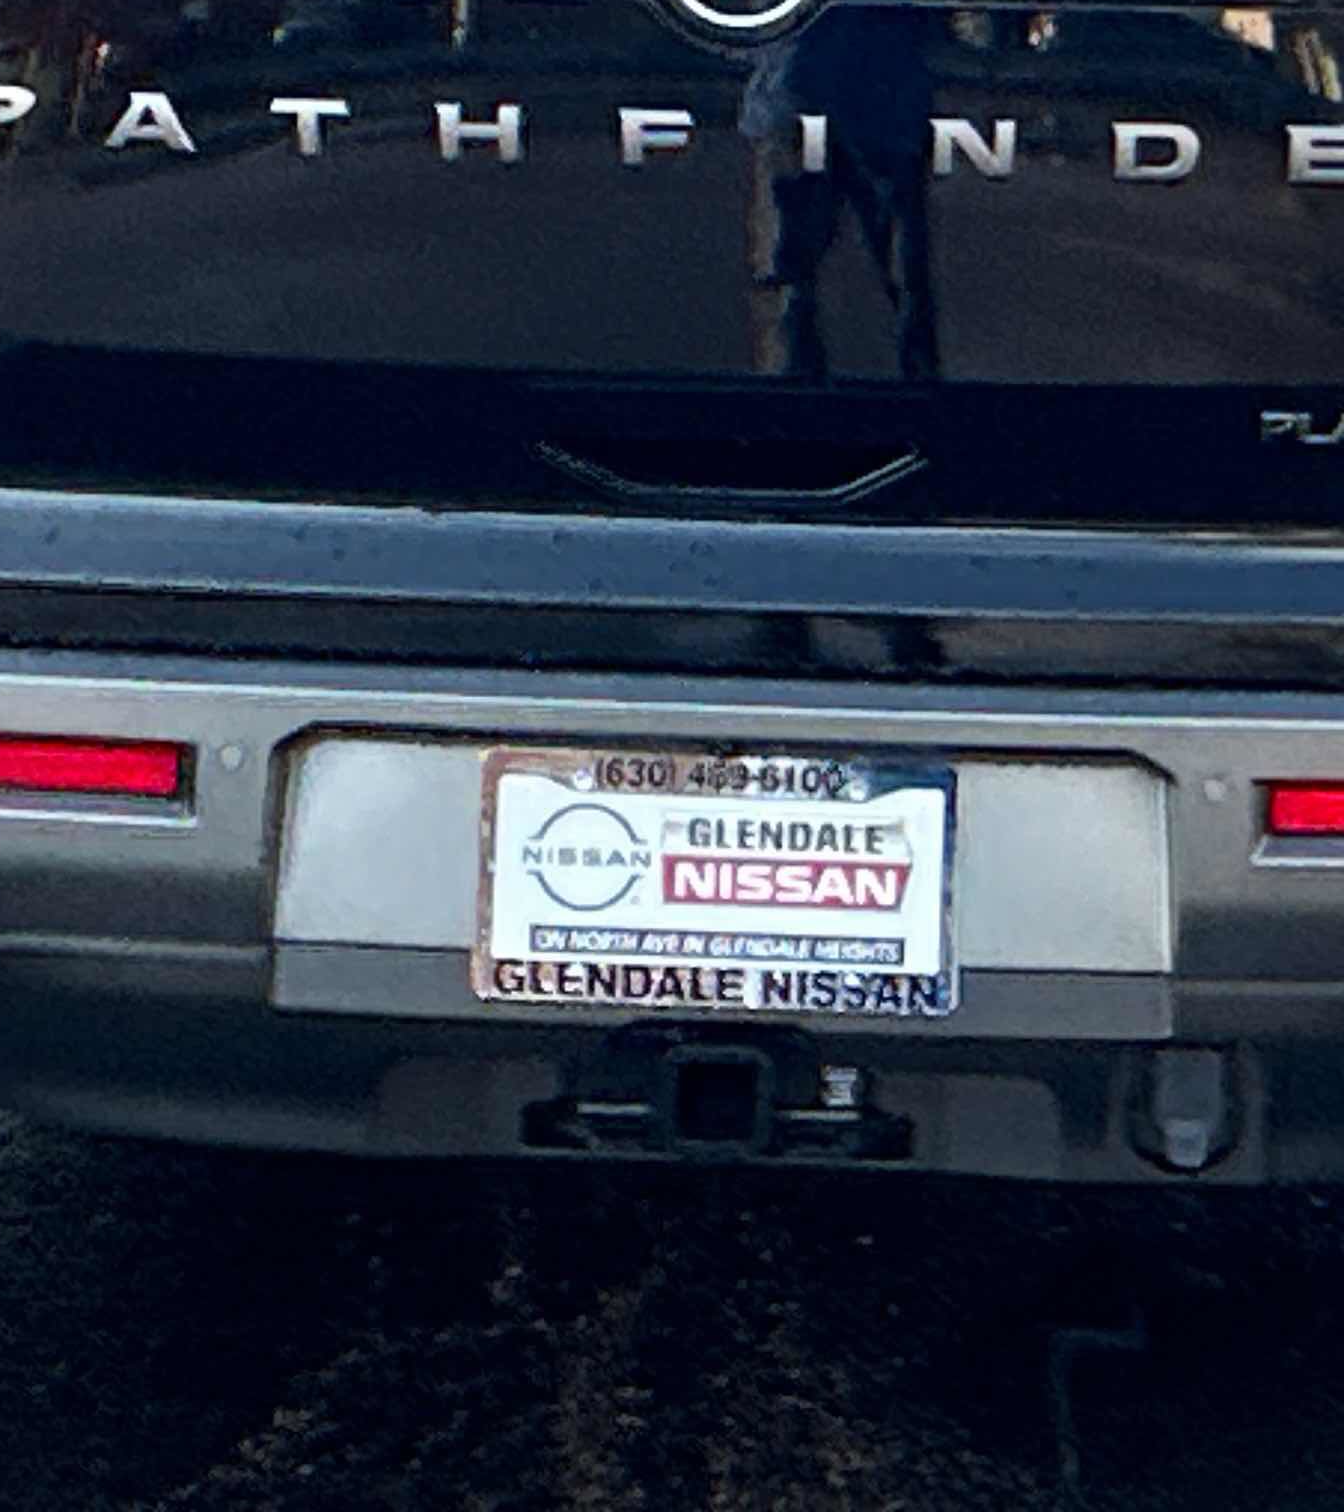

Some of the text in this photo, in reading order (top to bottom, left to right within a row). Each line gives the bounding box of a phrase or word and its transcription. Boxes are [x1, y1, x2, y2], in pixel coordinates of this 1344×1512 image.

[595, 757, 676, 787] (630)
[687, 816, 886, 854] GLENDALE
[523, 844, 651, 868] NISSAN
[674, 861, 898, 907] NISSAN
[494, 962, 939, 1010] GLENDALE NISSAN
